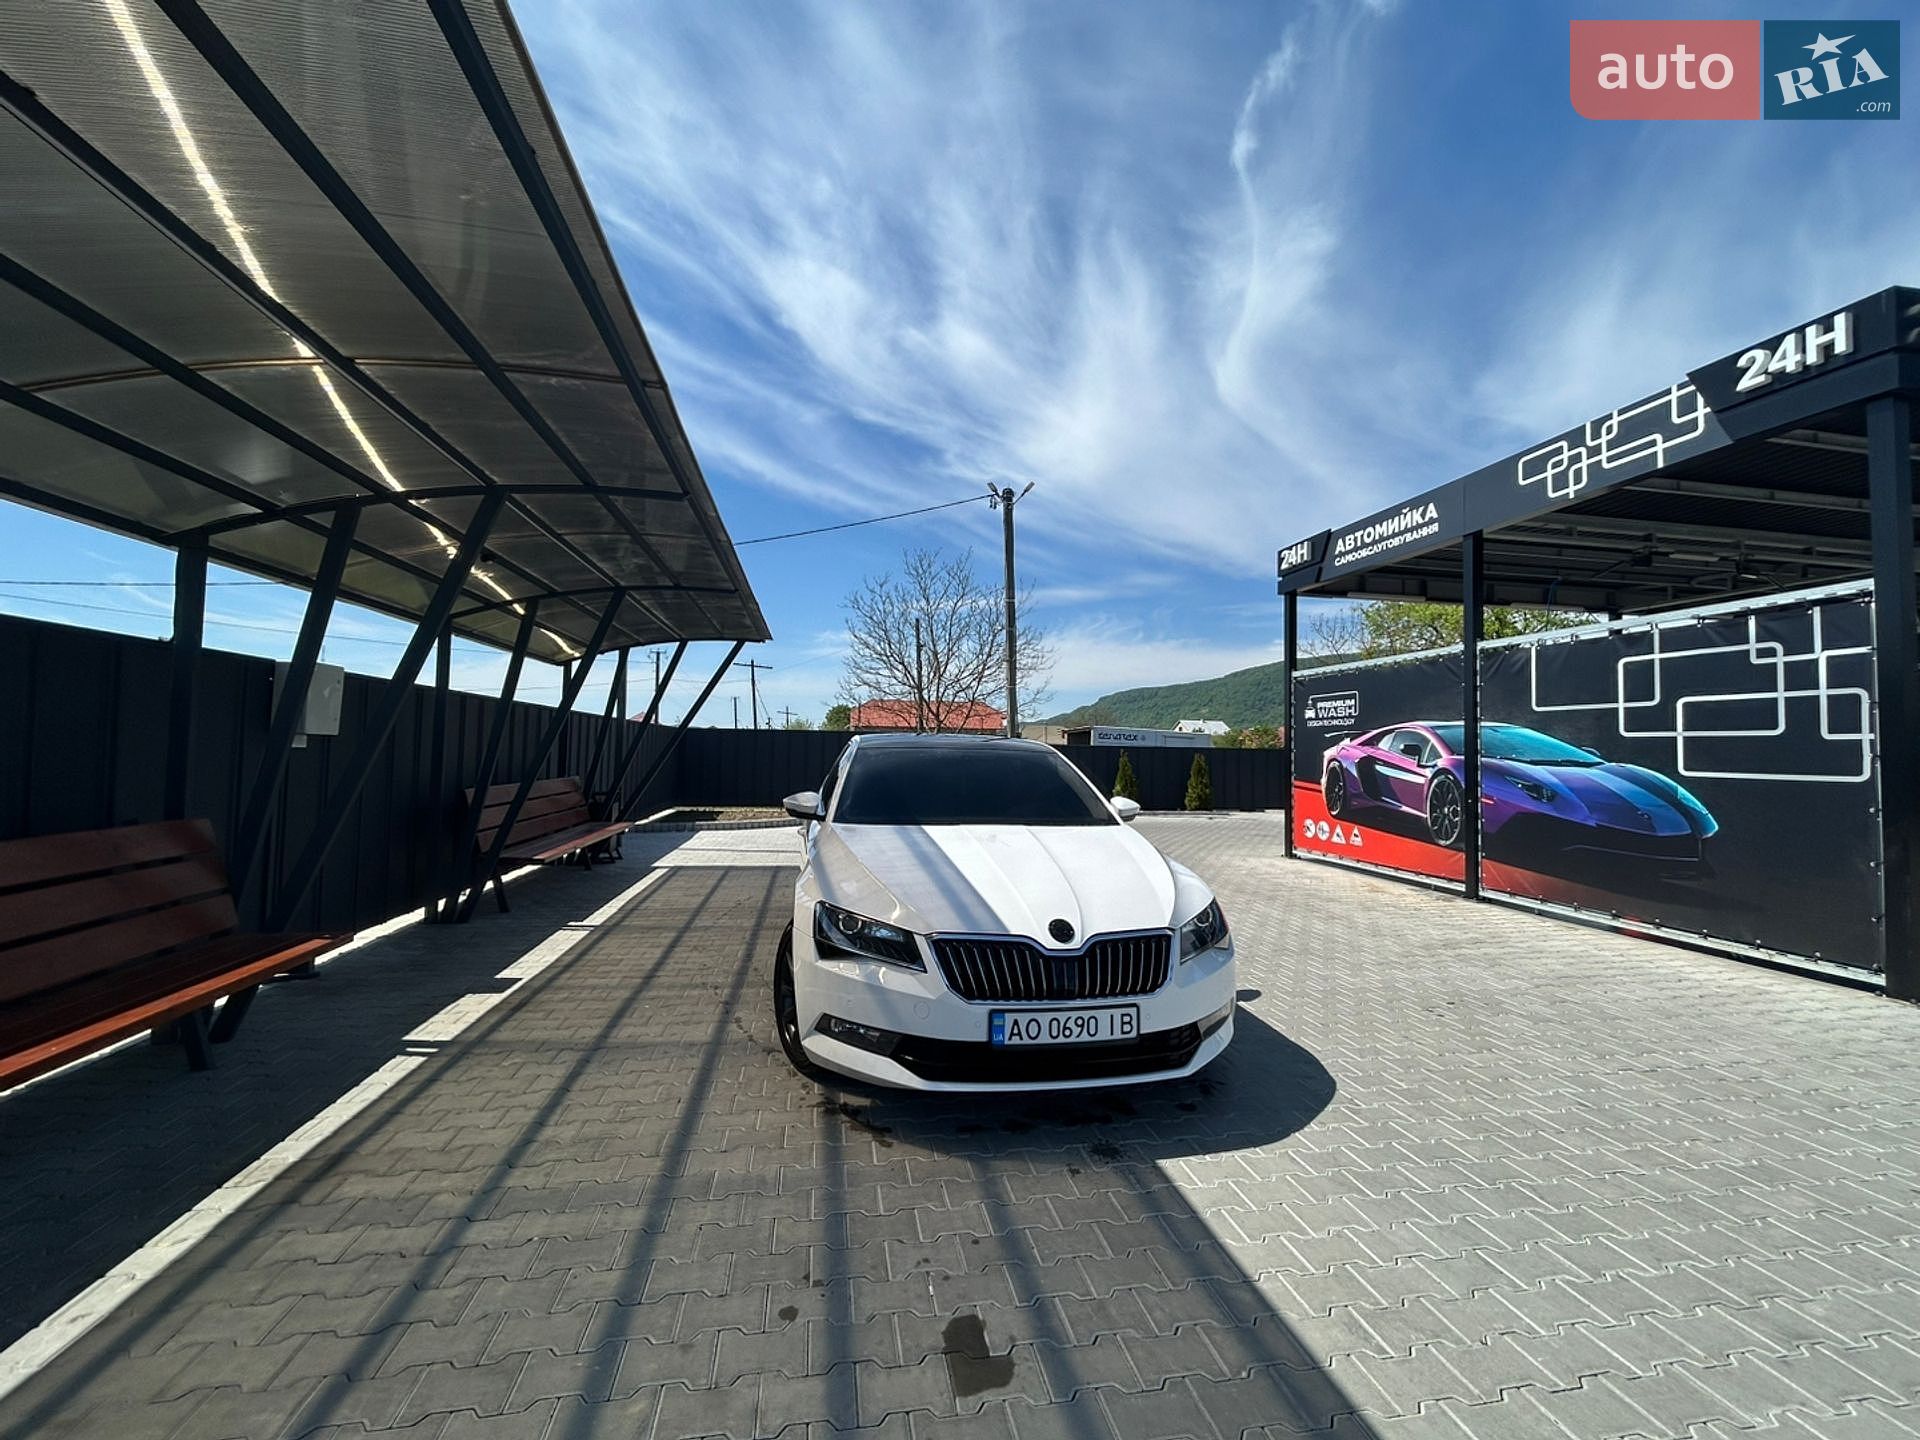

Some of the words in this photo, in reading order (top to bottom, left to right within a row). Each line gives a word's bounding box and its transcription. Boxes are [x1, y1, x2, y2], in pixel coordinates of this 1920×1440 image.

[1736, 312, 1853, 392] 24H
[1334, 502, 1439, 555] АВТОМИЙКА
[1280, 541, 1312, 570] 24H
[1334, 522, 1439, 566] САМООБСЛУГОВУВАННЯ
[1317, 699, 1355, 708] PREMIUM
[1317, 706, 1354, 718] WASH
[1008, 1018, 1041, 1041] AO
[1049, 1016, 1098, 1038] 0690
[1110, 1013, 1134, 1036] IB
